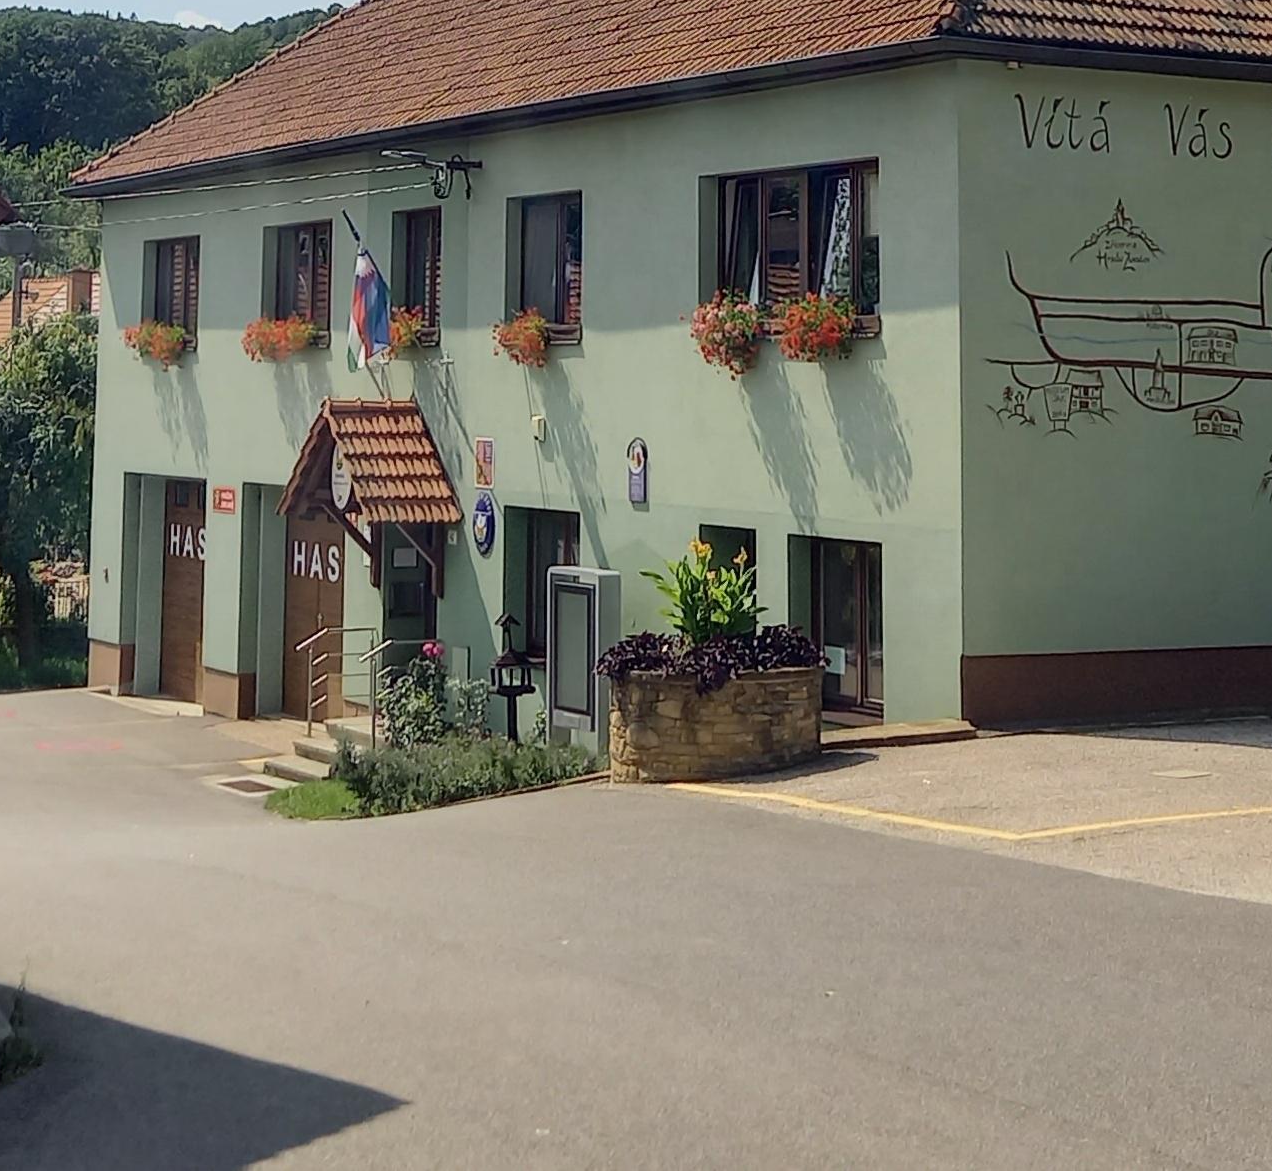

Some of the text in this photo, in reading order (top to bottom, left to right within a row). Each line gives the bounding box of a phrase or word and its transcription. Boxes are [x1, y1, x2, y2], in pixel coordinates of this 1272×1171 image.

[1014, 93, 1233, 160] Vítá Vás
[293, 540, 341, 583] HAS
